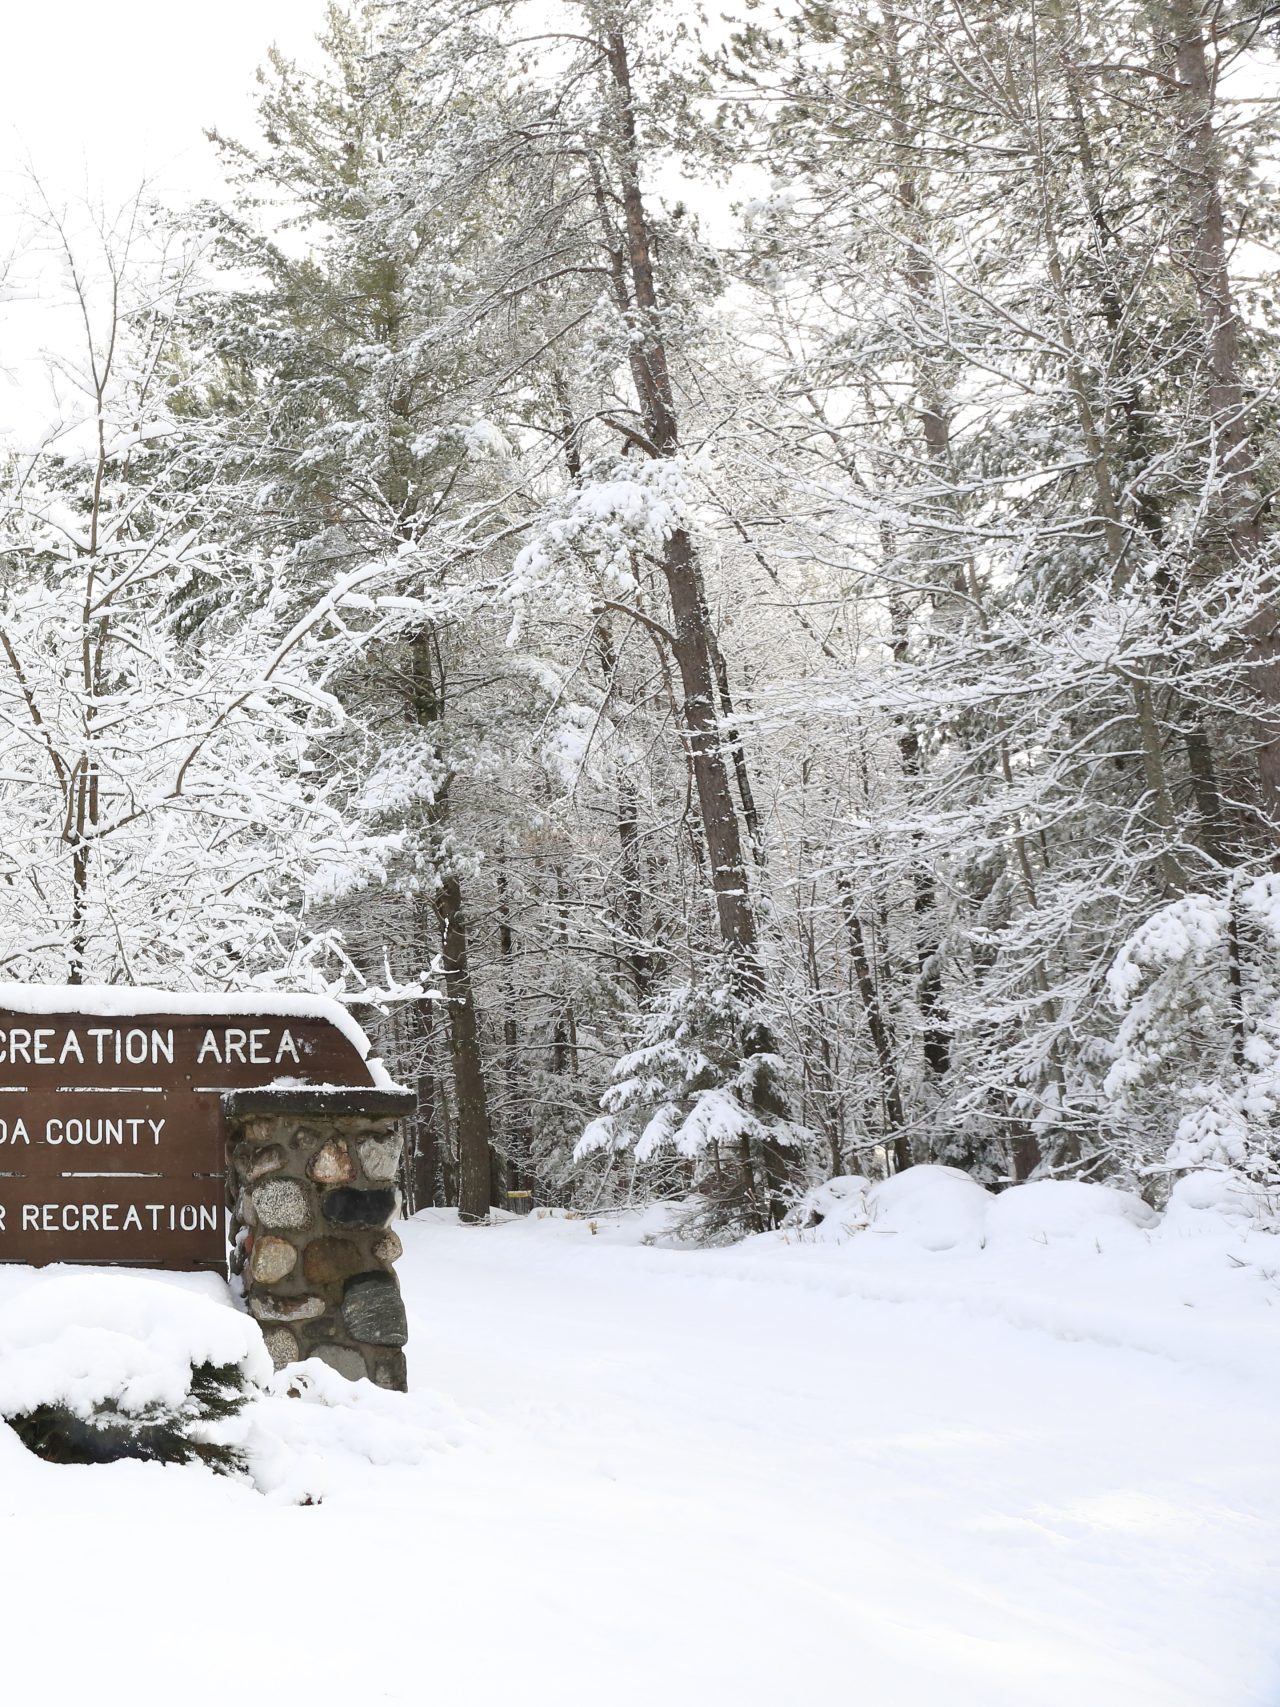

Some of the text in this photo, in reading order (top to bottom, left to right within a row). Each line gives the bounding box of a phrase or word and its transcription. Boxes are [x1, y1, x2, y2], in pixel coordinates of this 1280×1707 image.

[196, 1028, 300, 1064] AREA
[45, 1118, 166, 1145] COUNTY
[22, 1204, 217, 1231] RECREATION
